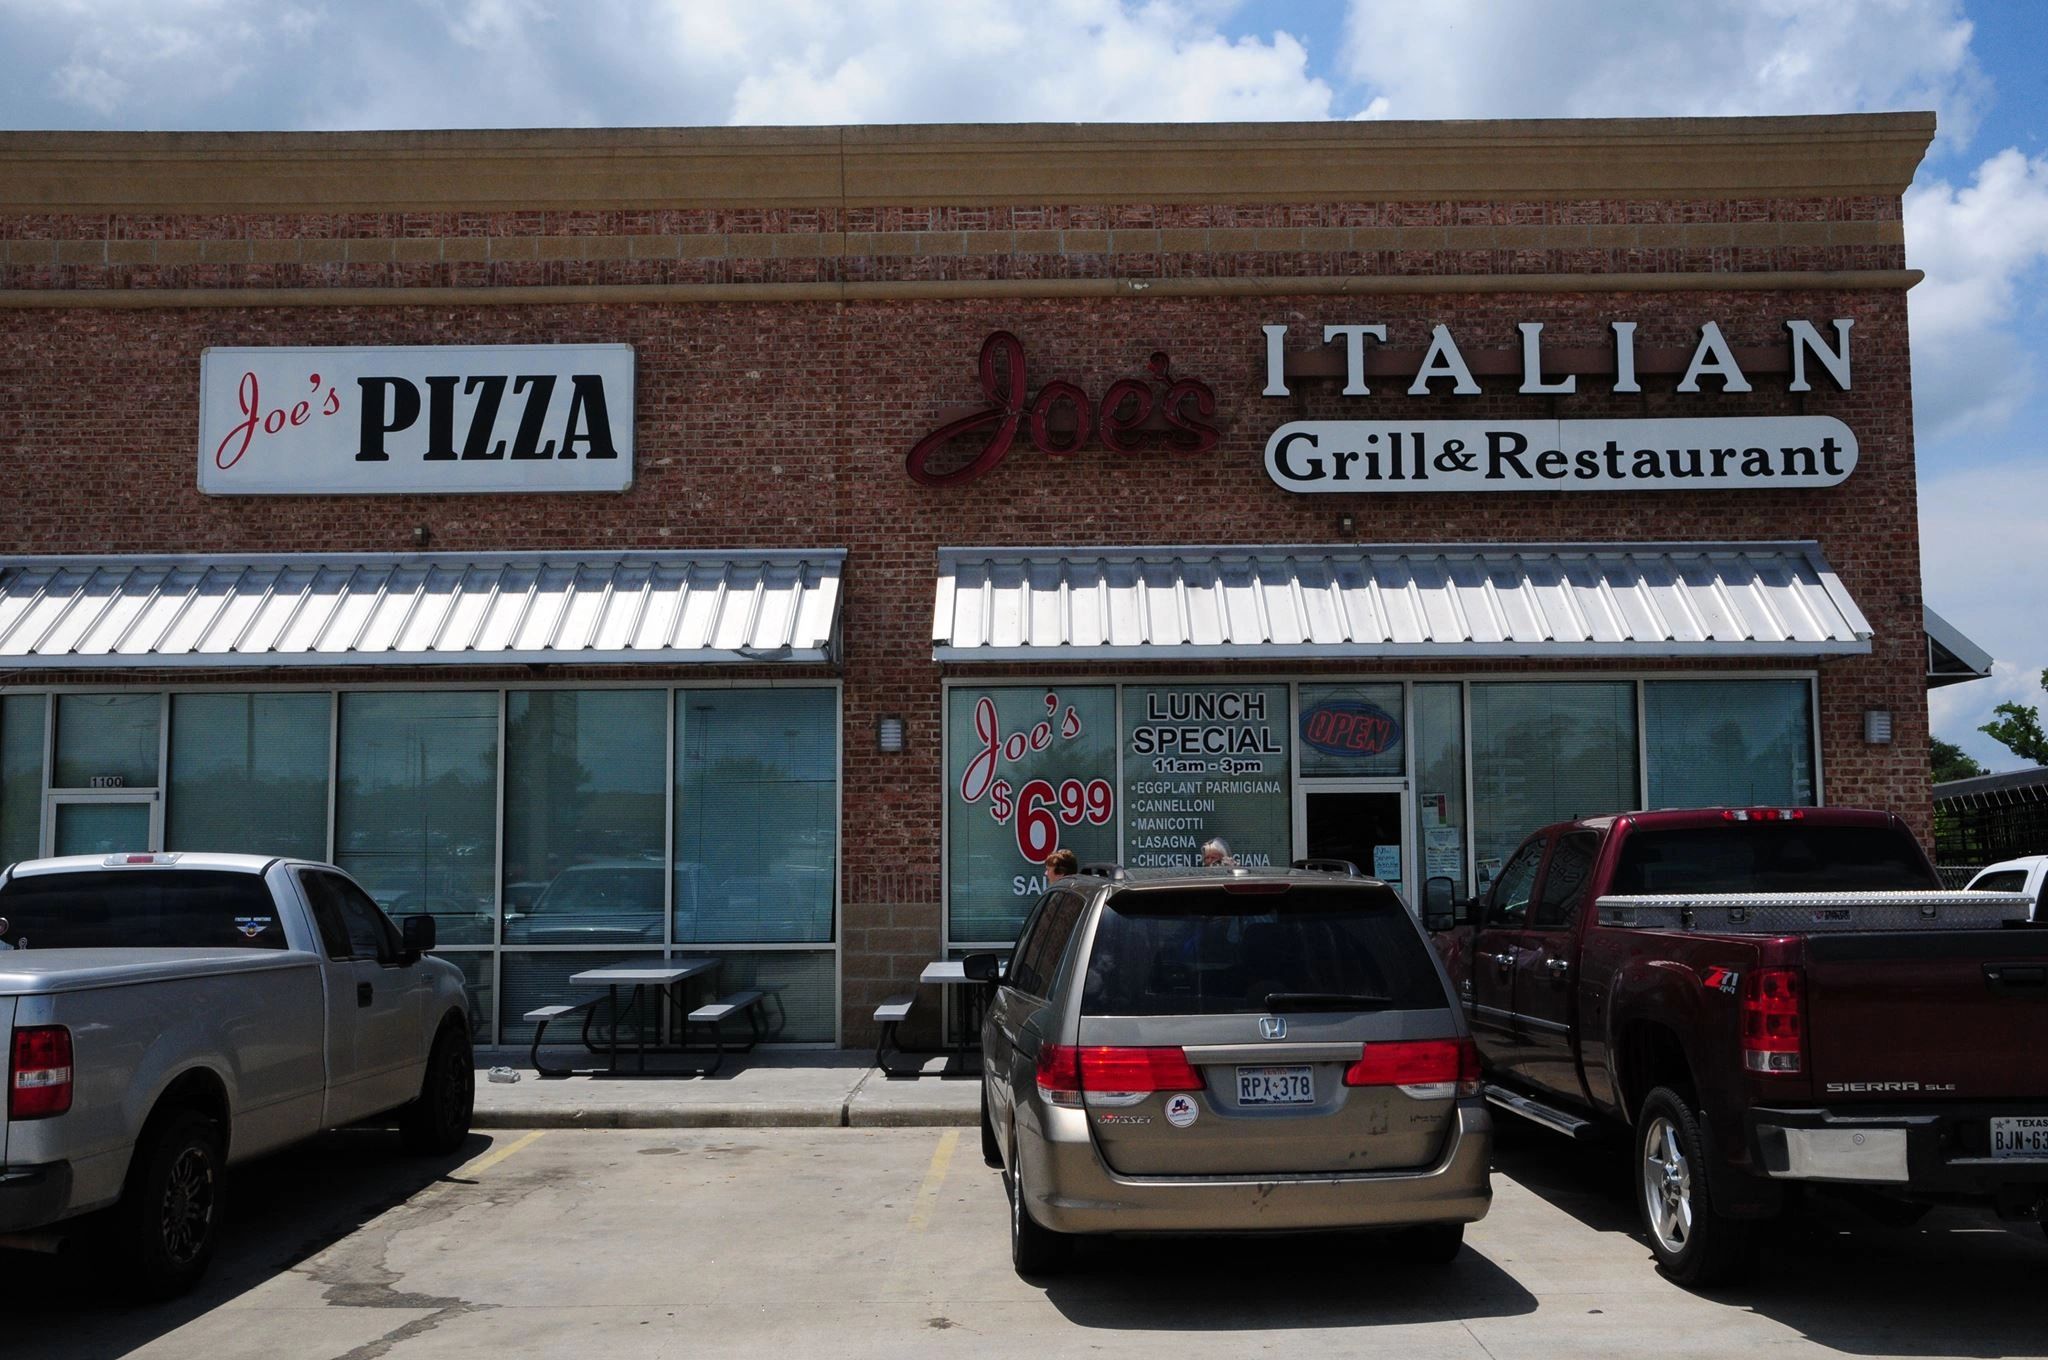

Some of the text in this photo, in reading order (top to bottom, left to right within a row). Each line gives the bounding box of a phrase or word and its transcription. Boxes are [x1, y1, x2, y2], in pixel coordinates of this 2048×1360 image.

[1262, 318, 1855, 397] ITALIAN
[905, 329, 1220, 487] Joe's
[215, 371, 618, 470] Joe's PIZZA
[1148, 693, 1266, 721] LUNCH
[1133, 726, 1282, 755] SPECIAL
[1308, 711, 1391, 753] OPEN
[961, 693, 1081, 803] Joe's
[1153, 757, 1205, 773] 11am
[1220, 757, 1262, 775] 3pm
[92, 777, 122, 788] 1100
[1137, 781, 1281, 794] EGGPLANT PARMIGIANA
[1137, 799, 1215, 812] CANNELLONI
[1138, 817, 1203, 830] MANICOTTI
[1138, 836, 1196, 849] LASAGNA
[1138, 854, 1270, 867] CHICKEN PGIANA
[1704, 965, 1739, 986] Z71
[1826, 1081, 1920, 1092] SIERRA
[2016, 1119, 2048, 1128] TEXAS
